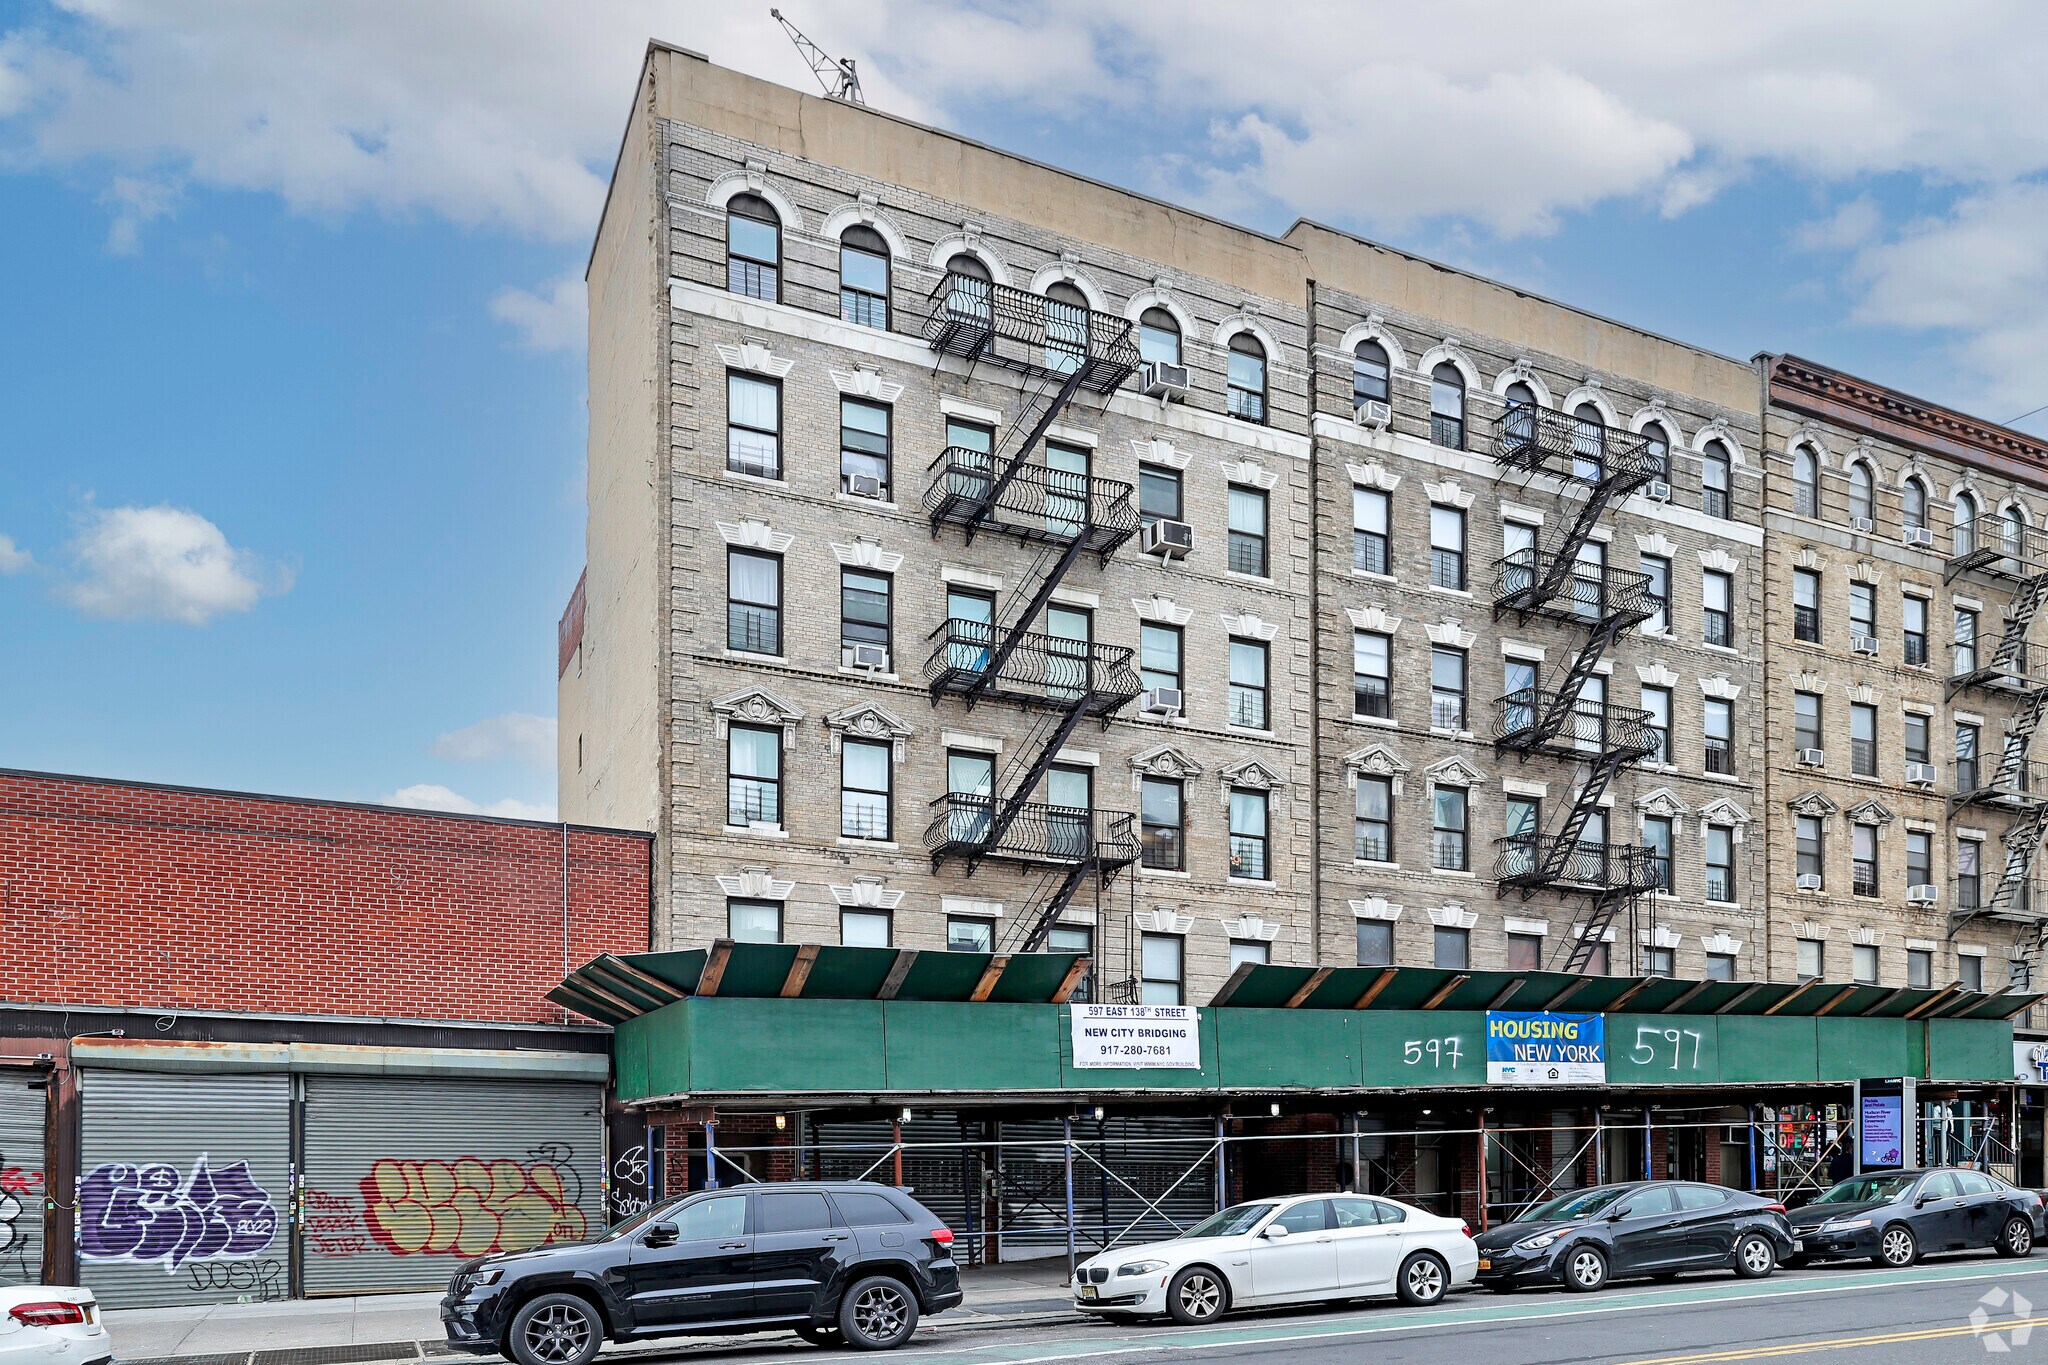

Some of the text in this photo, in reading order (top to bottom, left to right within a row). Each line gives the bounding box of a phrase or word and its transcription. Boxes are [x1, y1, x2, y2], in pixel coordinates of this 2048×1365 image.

[1088, 1006, 1187, 1018] 597 EAST 138TH STREET
[1084, 1028, 1187, 1038] NEW CITY BRIDGING
[1489, 1019, 1579, 1040] HOUSING
[1100, 1045, 1171, 1055] 917-280-7681
[1403, 1036, 1464, 1069] 597
[1514, 1043, 1601, 1063] NEW YORK
[1629, 1026, 1701, 1070] 597
[235, 1218, 273, 1236] 2022
